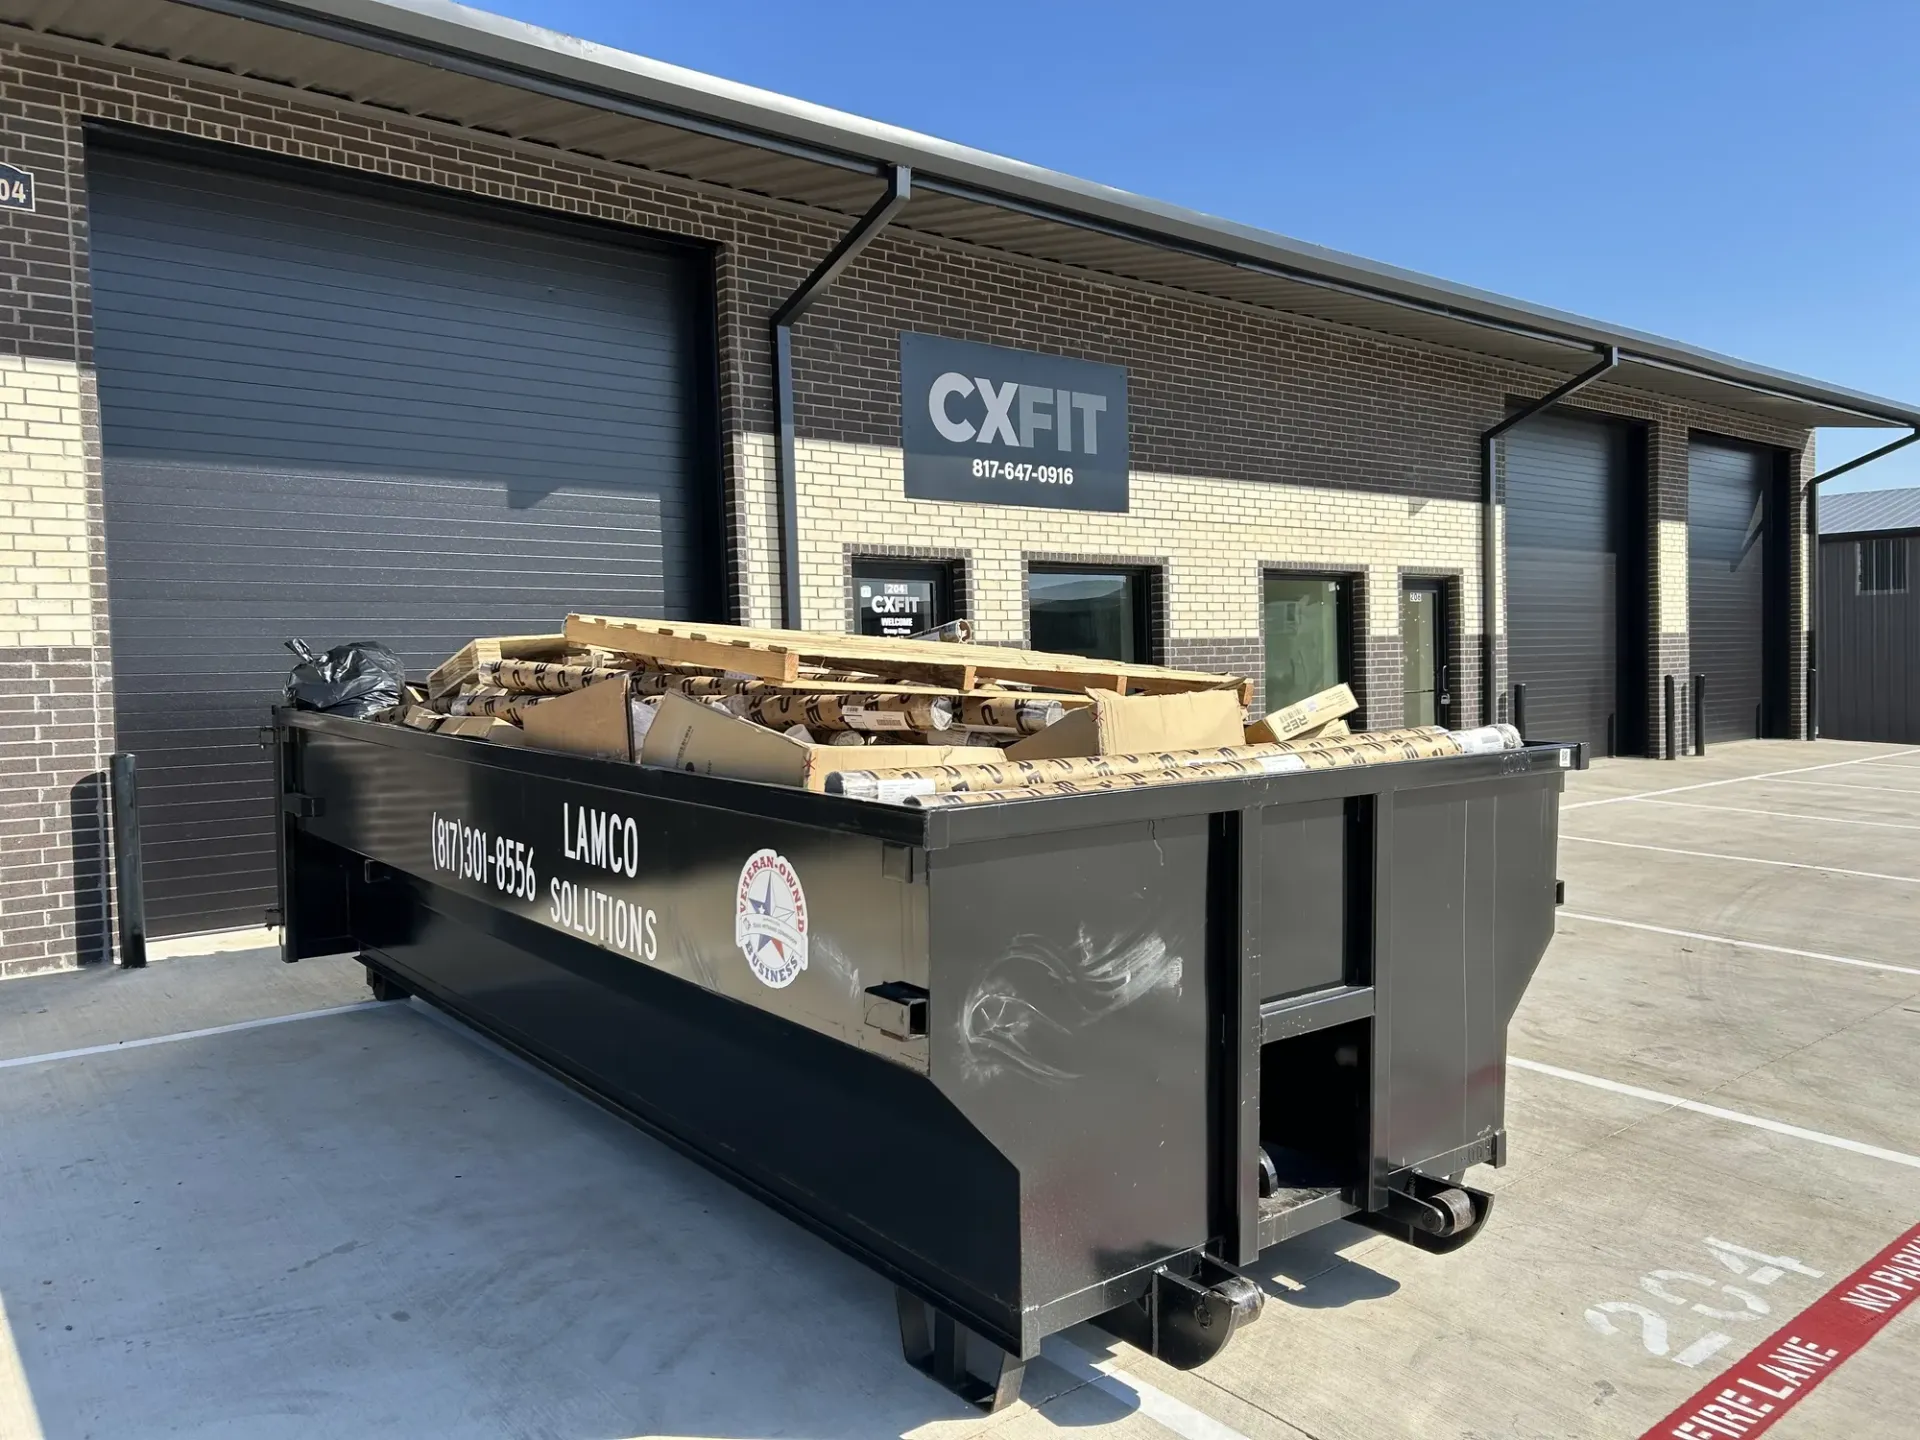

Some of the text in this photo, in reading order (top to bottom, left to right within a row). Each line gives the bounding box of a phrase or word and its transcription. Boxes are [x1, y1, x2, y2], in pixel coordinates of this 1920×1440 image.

[928, 371, 1107, 455] CXFIT
[972, 458, 1074, 485] 817-647-0916
[871, 595, 920, 613] CXFIT
[887, 583, 905, 594] 204
[881, 617, 913, 627] WELCOME
[1282, 713, 1310, 734] REP
[431, 811, 537, 903] (817)301-8556
[563, 802, 638, 879] LAMCO
[550, 876, 658, 962] SOLUTIONS
[745, 939, 798, 984] BUSINESS
[1583, 1236, 1826, 1369] 204
[1671, 1388, 1775, 1440] FIRE
[1736, 1335, 1839, 1400] LANE
[1840, 1283, 1902, 1313] NO
